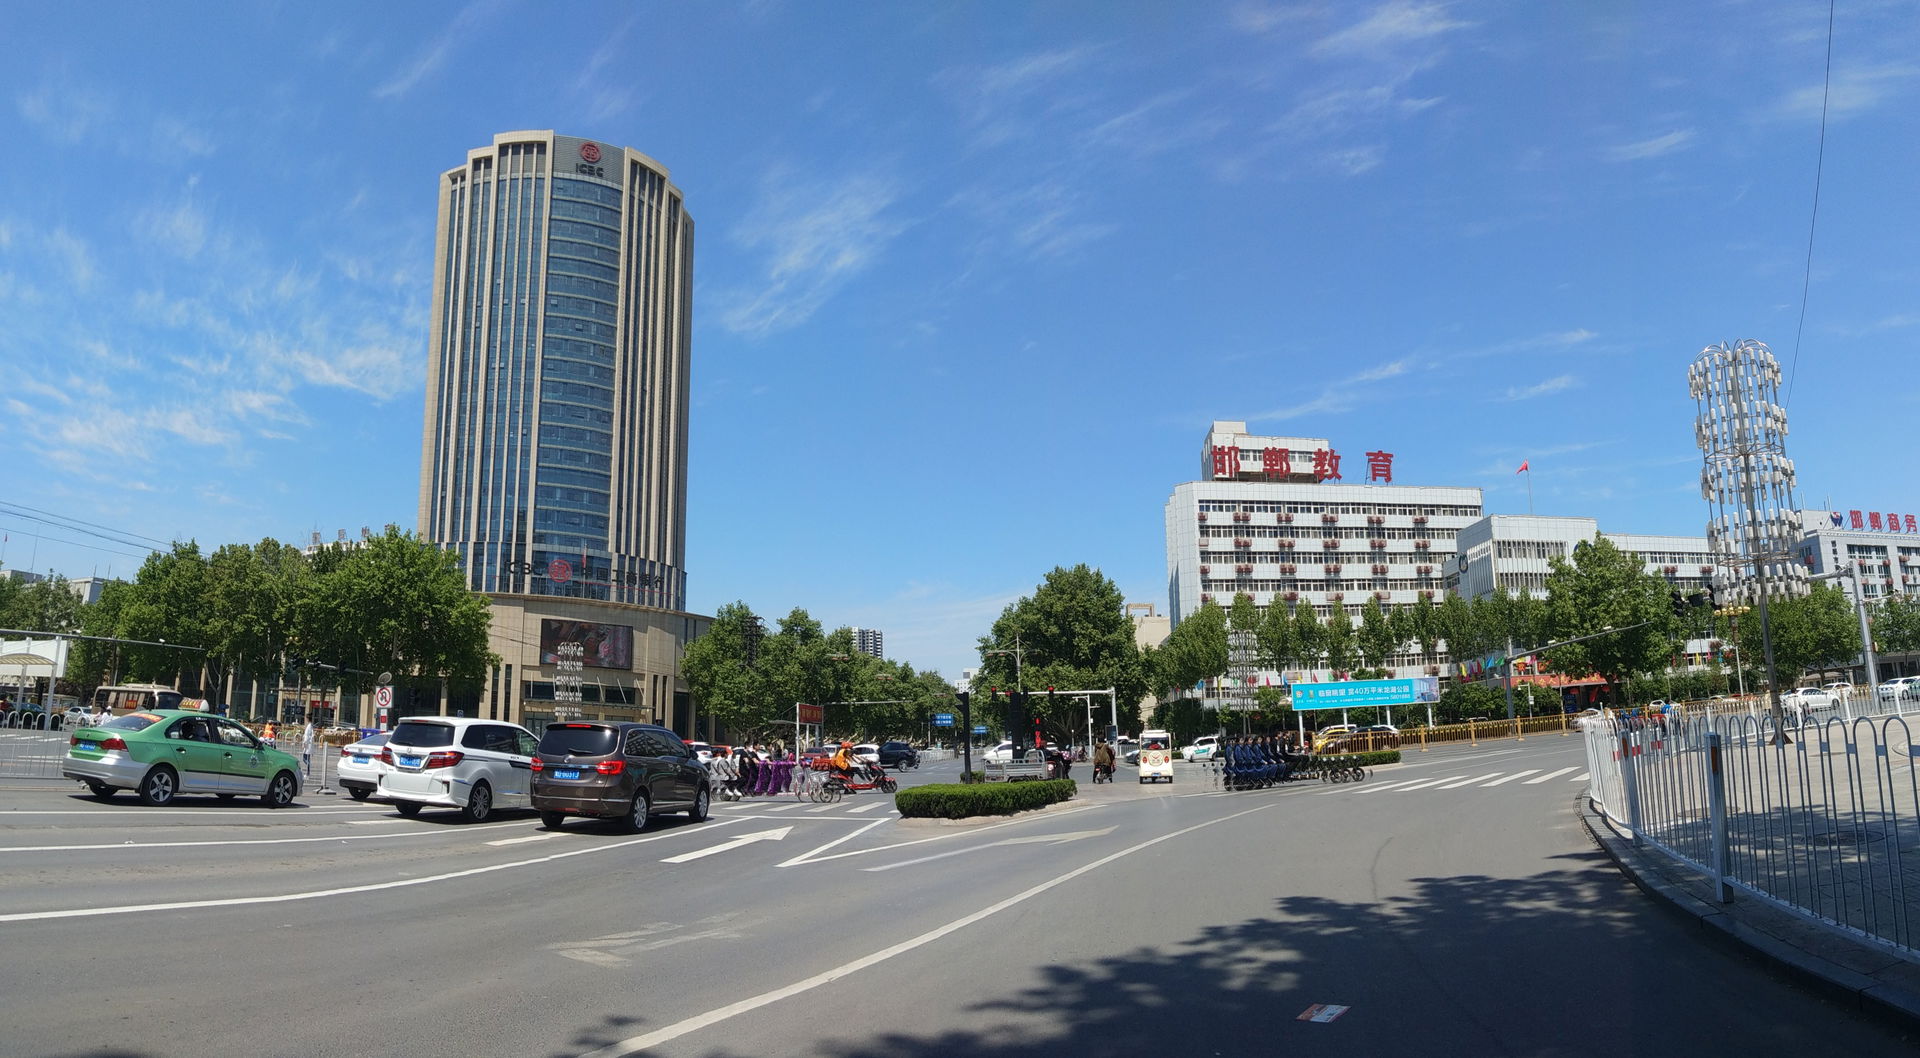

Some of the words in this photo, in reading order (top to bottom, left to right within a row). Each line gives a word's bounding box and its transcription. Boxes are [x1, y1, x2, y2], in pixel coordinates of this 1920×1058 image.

[576, 163, 604, 178] ICBC
[1211, 445, 1393, 482] 邯郸教育
[504, 560, 542, 576] ICBC
